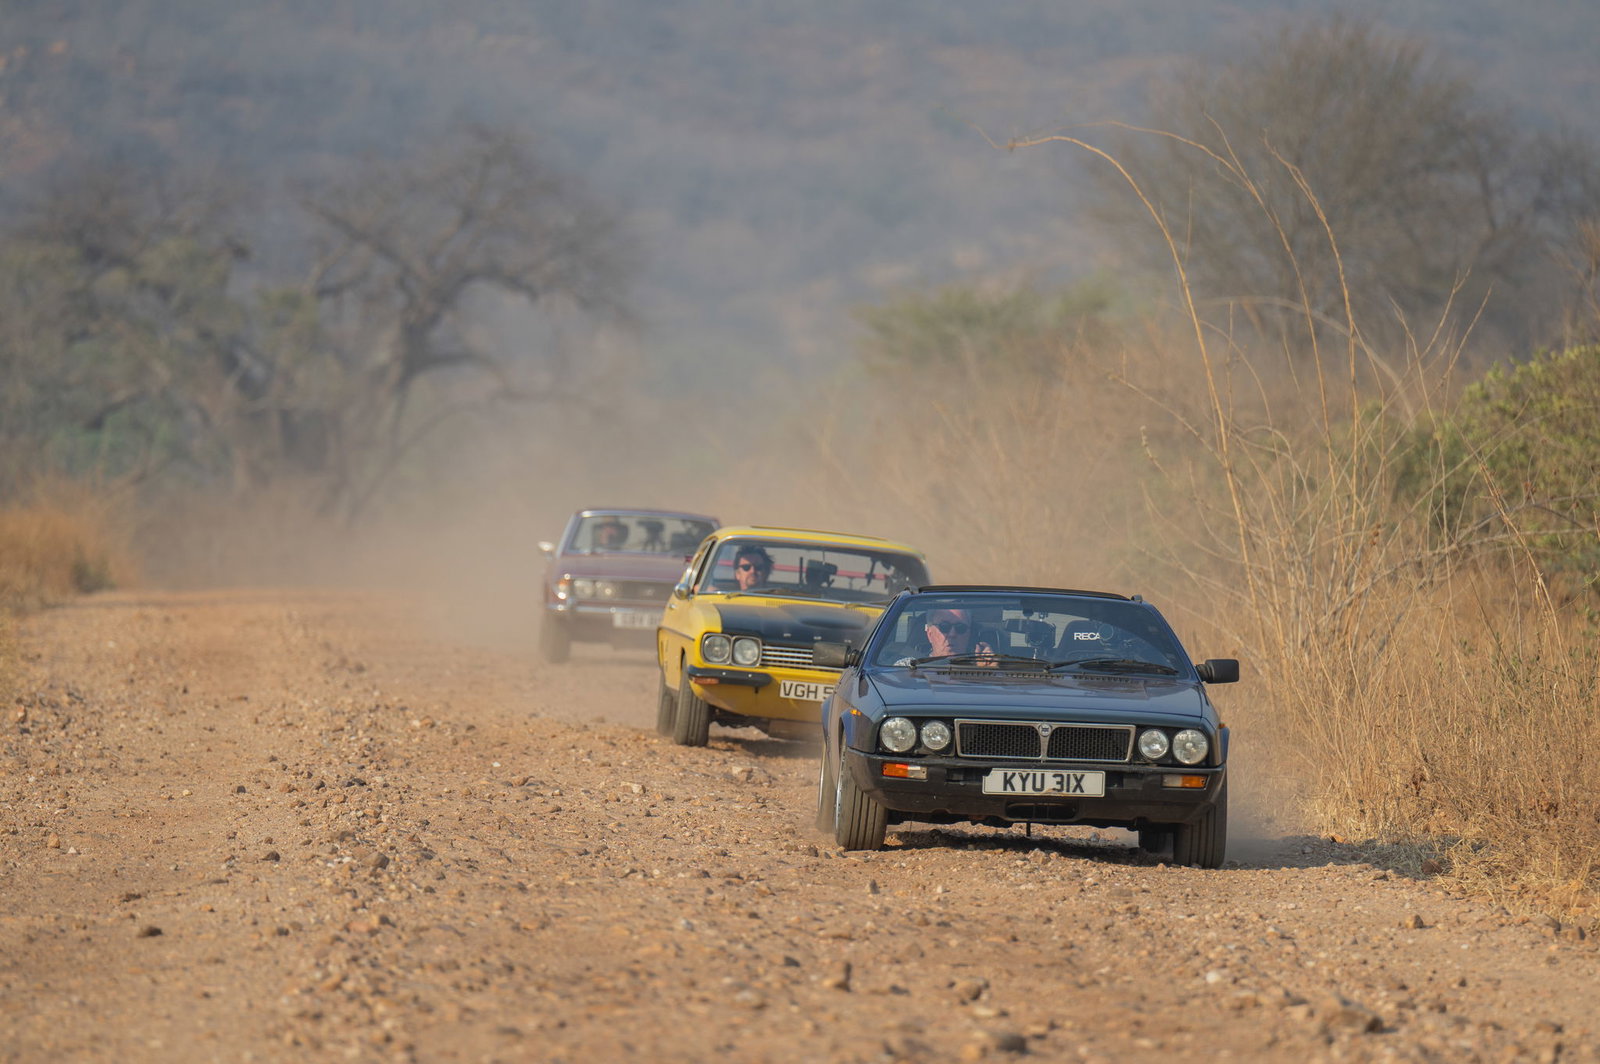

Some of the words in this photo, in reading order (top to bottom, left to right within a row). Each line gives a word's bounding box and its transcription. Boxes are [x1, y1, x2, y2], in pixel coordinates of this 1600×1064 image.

[783, 682, 818, 699] VGH
[1003, 772, 1045, 792] KYU
[1052, 773, 1085, 793] 31X
